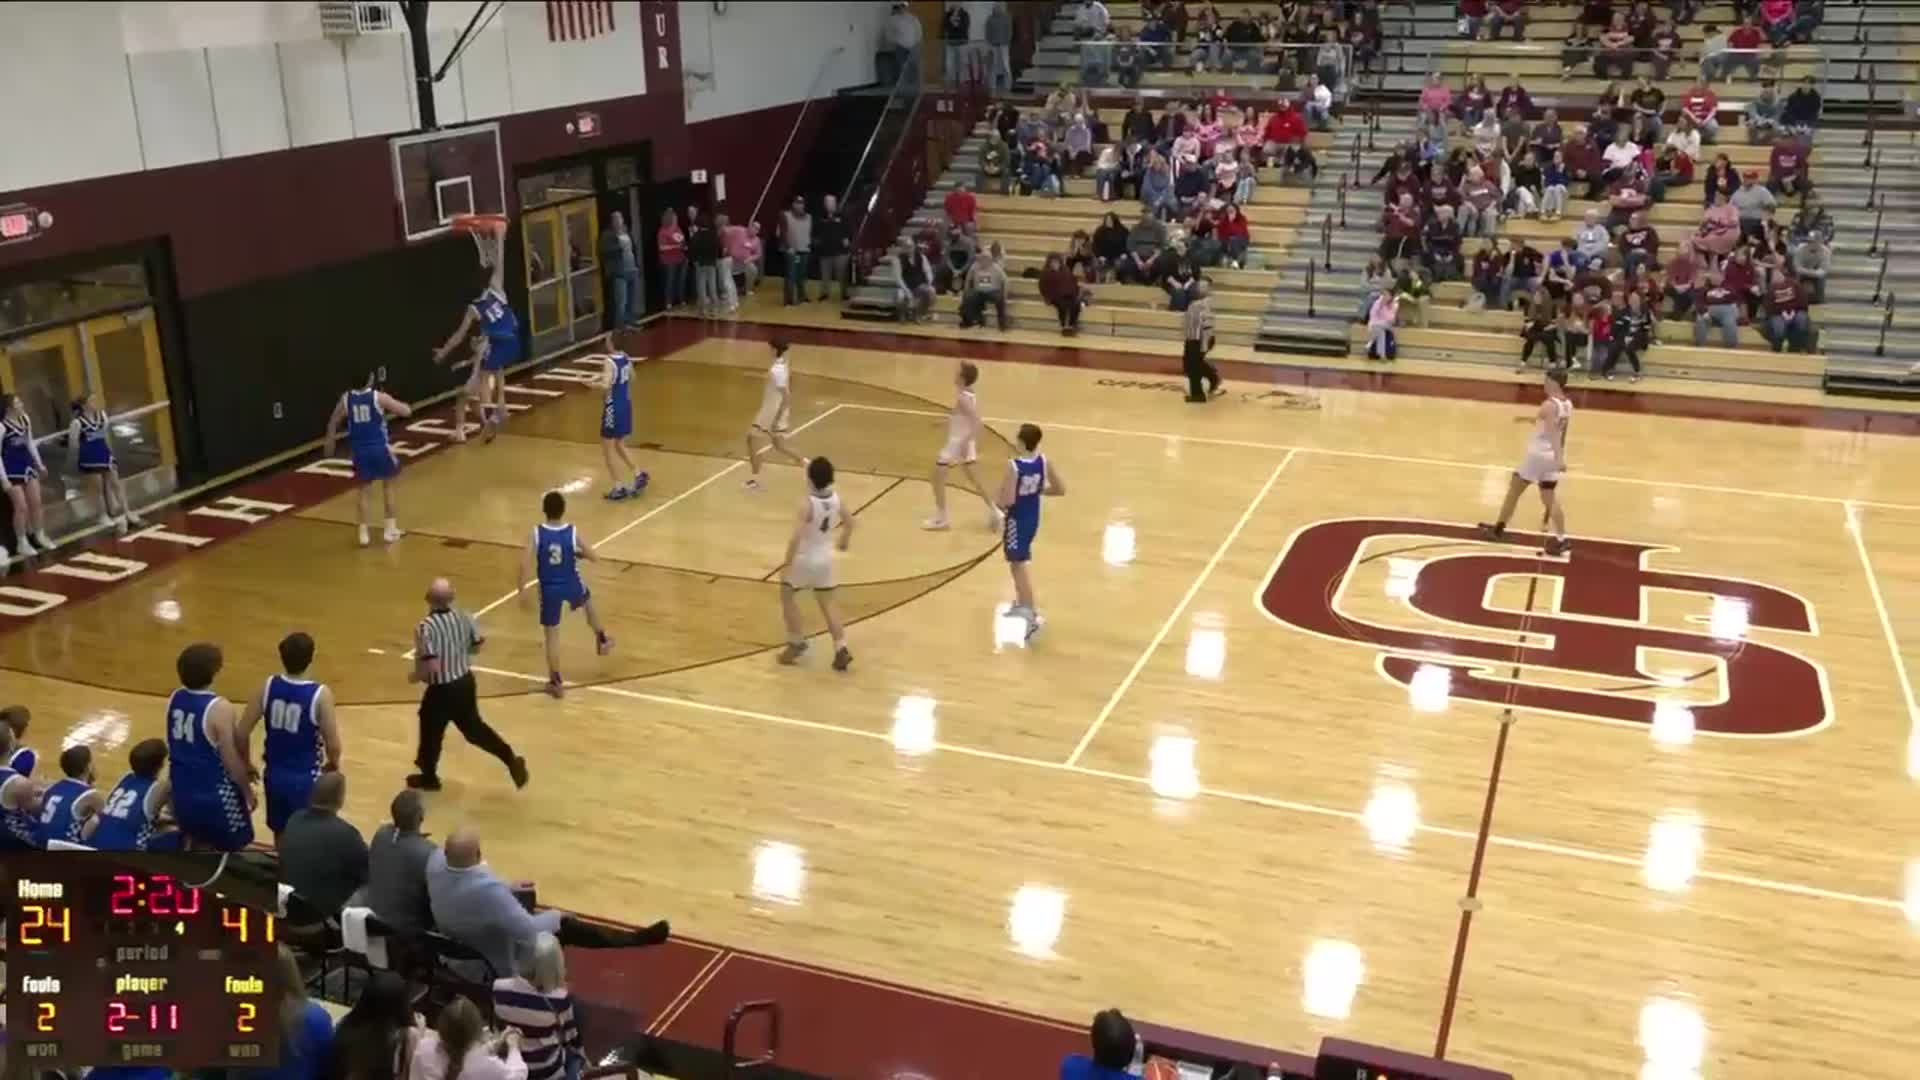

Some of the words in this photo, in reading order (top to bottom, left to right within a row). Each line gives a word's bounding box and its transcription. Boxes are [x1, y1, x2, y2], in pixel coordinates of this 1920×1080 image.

[818, 515, 830, 534] 4
[548, 542, 562, 565] 3
[171, 708, 196, 744] 34
[270, 698, 302, 733] 00
[40, 794, 64, 824] 5
